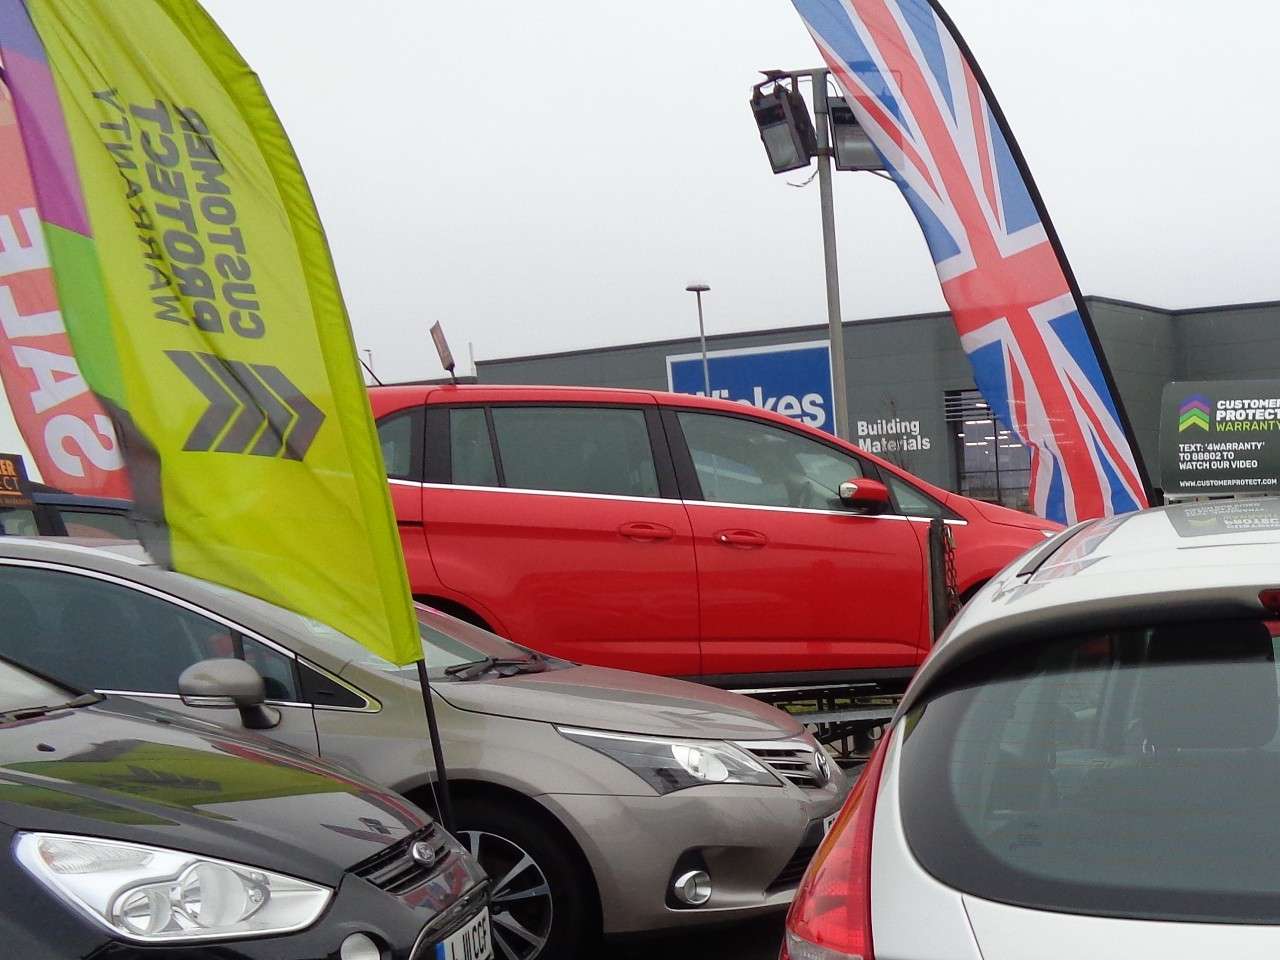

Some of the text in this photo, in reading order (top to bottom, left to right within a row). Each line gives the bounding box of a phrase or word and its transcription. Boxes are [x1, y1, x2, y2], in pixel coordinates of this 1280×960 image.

[857, 418, 920, 436] Building
[858, 435, 931, 453] Materials
[1179, 444, 1204, 452] TEXT:
[1179, 453, 1189, 461] TO
[1223, 451, 1234, 460] TO
[1179, 460, 1258, 471] WATCH OUR VIDEO
[1179, 479, 1278, 487] WWW.CUSTOMERPROTECT.COM
